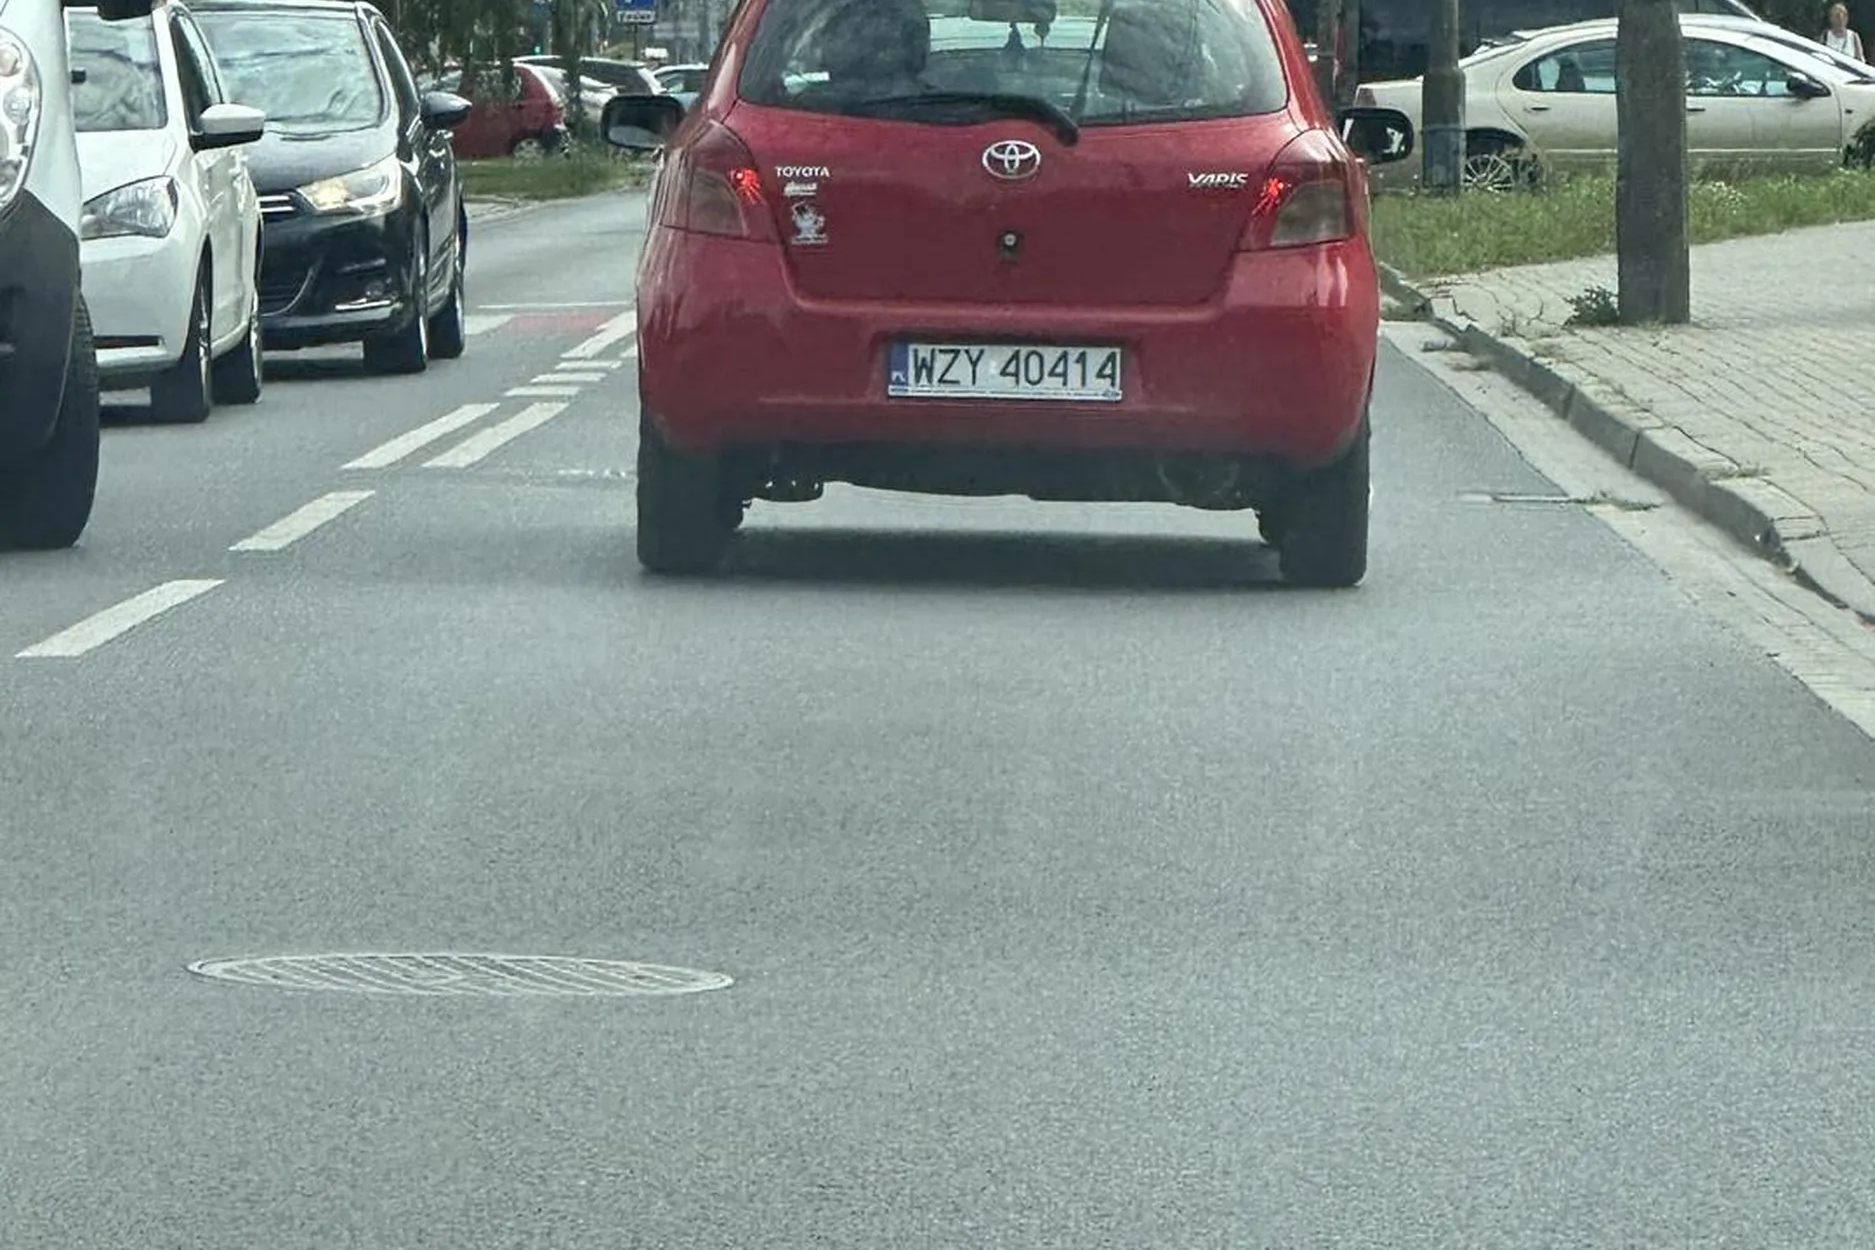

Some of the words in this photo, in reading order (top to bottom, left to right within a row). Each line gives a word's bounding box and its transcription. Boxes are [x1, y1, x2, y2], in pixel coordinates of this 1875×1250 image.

[774, 165, 830, 178] TOYOTA
[912, 347, 985, 386] WZY
[999, 349, 1117, 388] 40414
